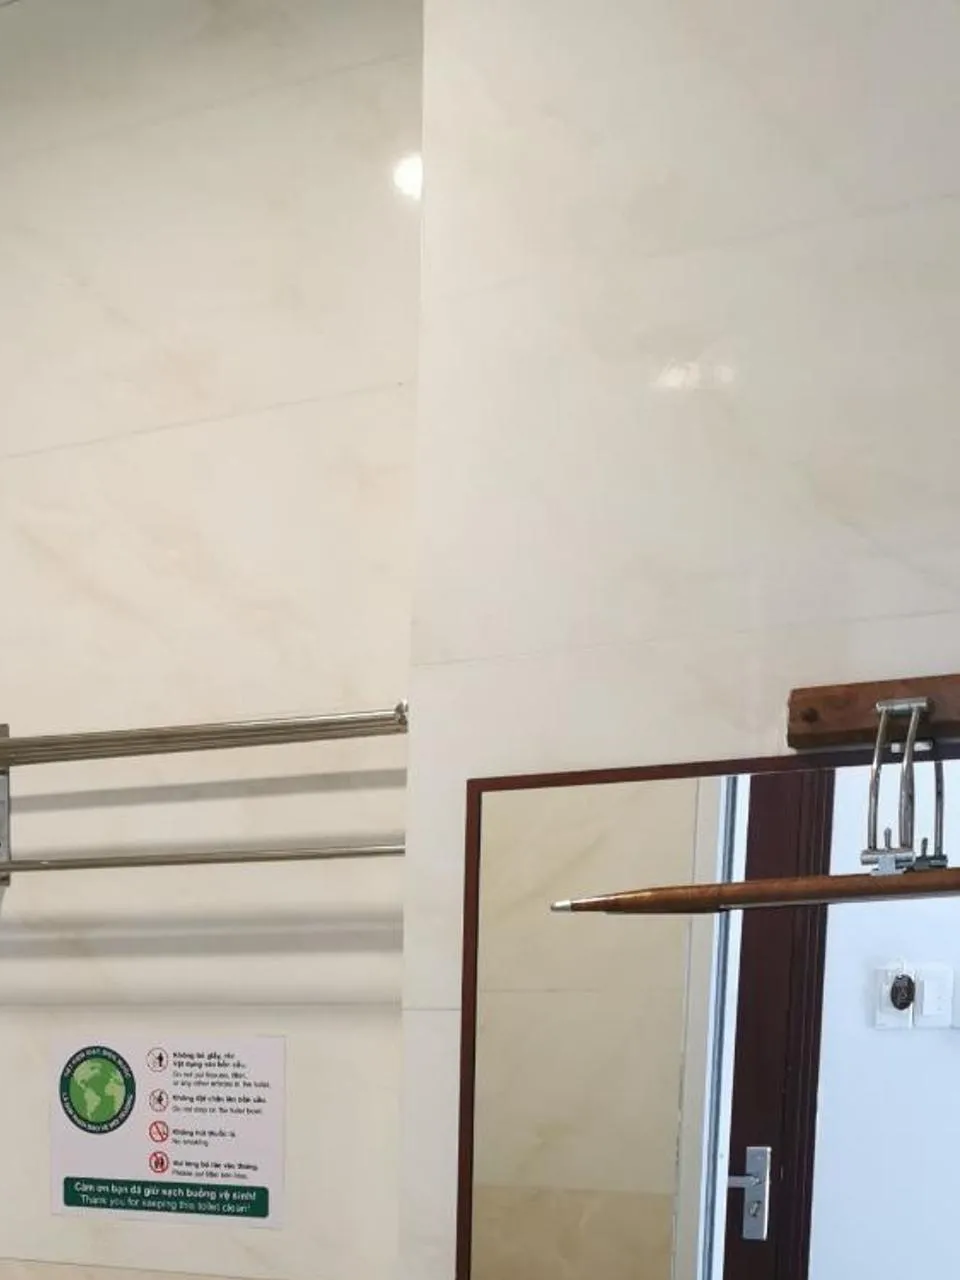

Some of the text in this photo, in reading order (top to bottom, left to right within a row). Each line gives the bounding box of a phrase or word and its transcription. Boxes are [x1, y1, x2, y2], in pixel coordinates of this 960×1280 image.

[111, 1183, 128, 1195] bạn
[81, 1194, 107, 1204] Thank
[110, 1197, 126, 1207] you
[128, 1196, 140, 1206] for
